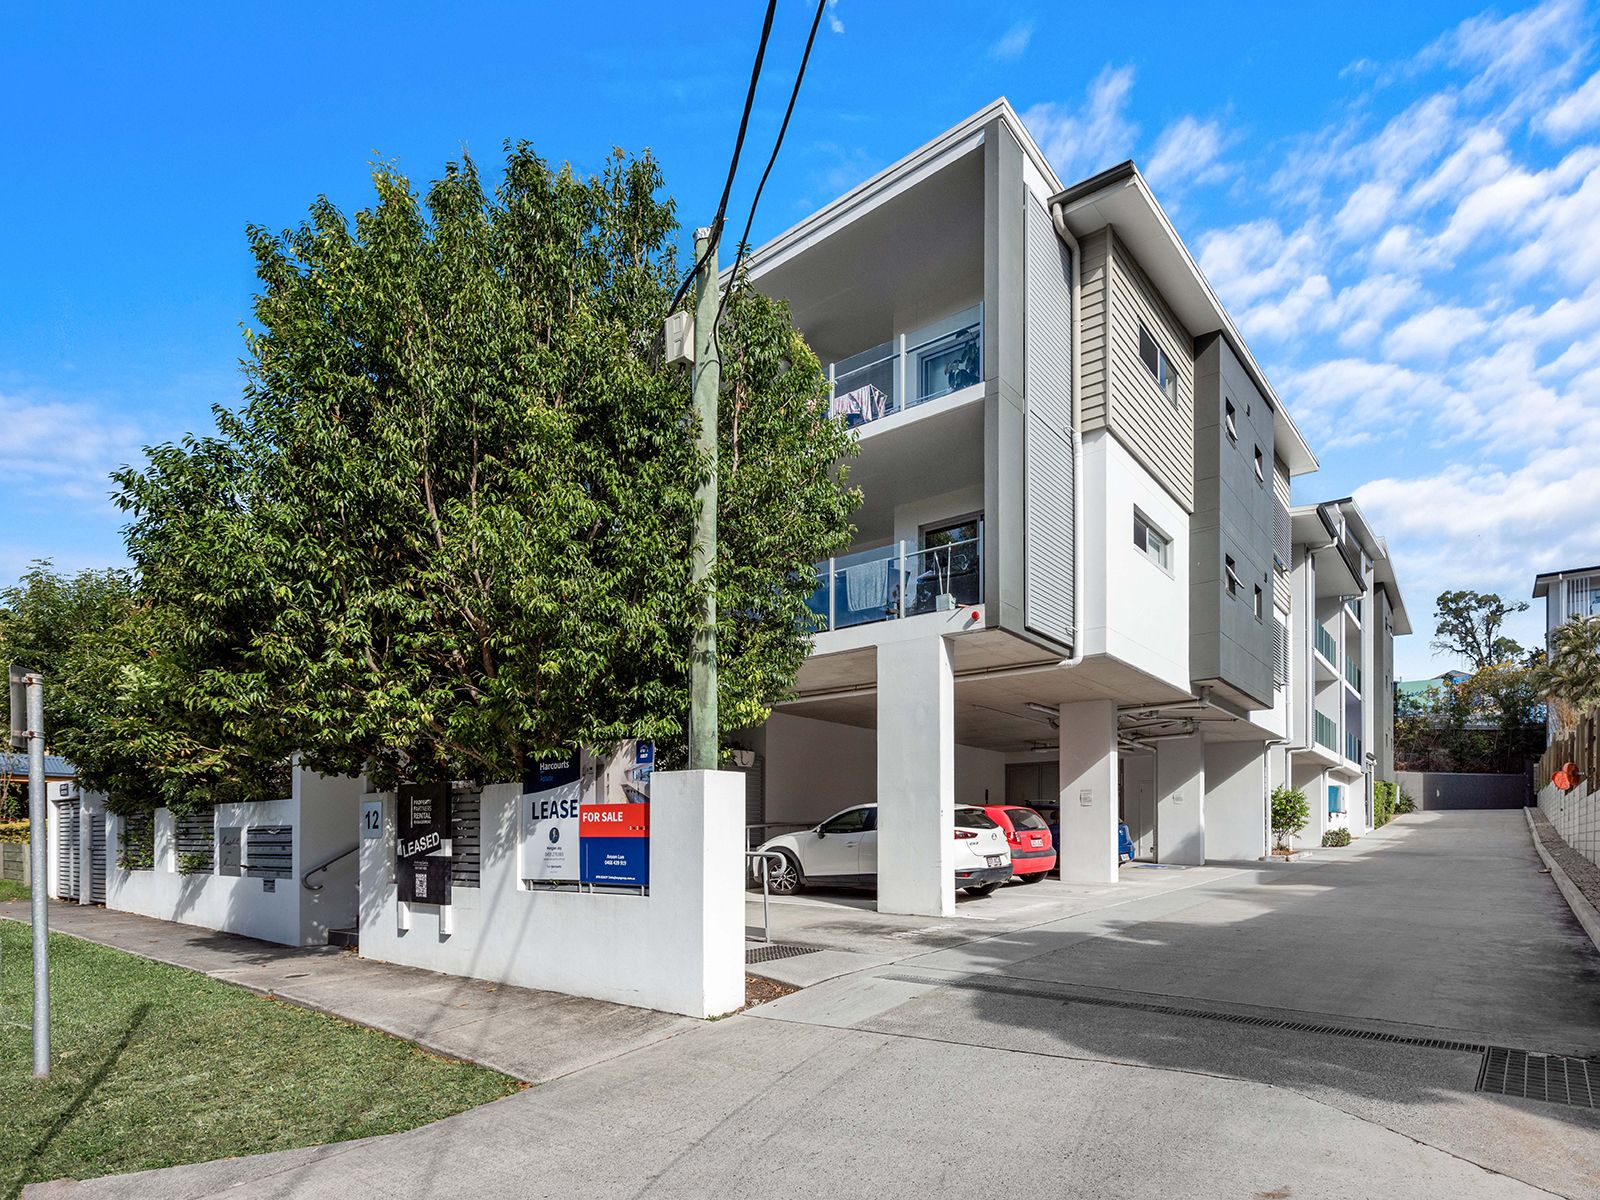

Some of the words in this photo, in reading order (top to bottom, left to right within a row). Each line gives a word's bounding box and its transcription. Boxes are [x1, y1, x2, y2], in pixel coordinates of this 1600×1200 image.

[539, 760, 570, 771] Harcourts
[532, 799, 578, 820] LEASE
[582, 812, 600, 822] FOR
[601, 811, 624, 822] SALE
[365, 810, 379, 830] 12
[402, 832, 440, 858] LEASED
